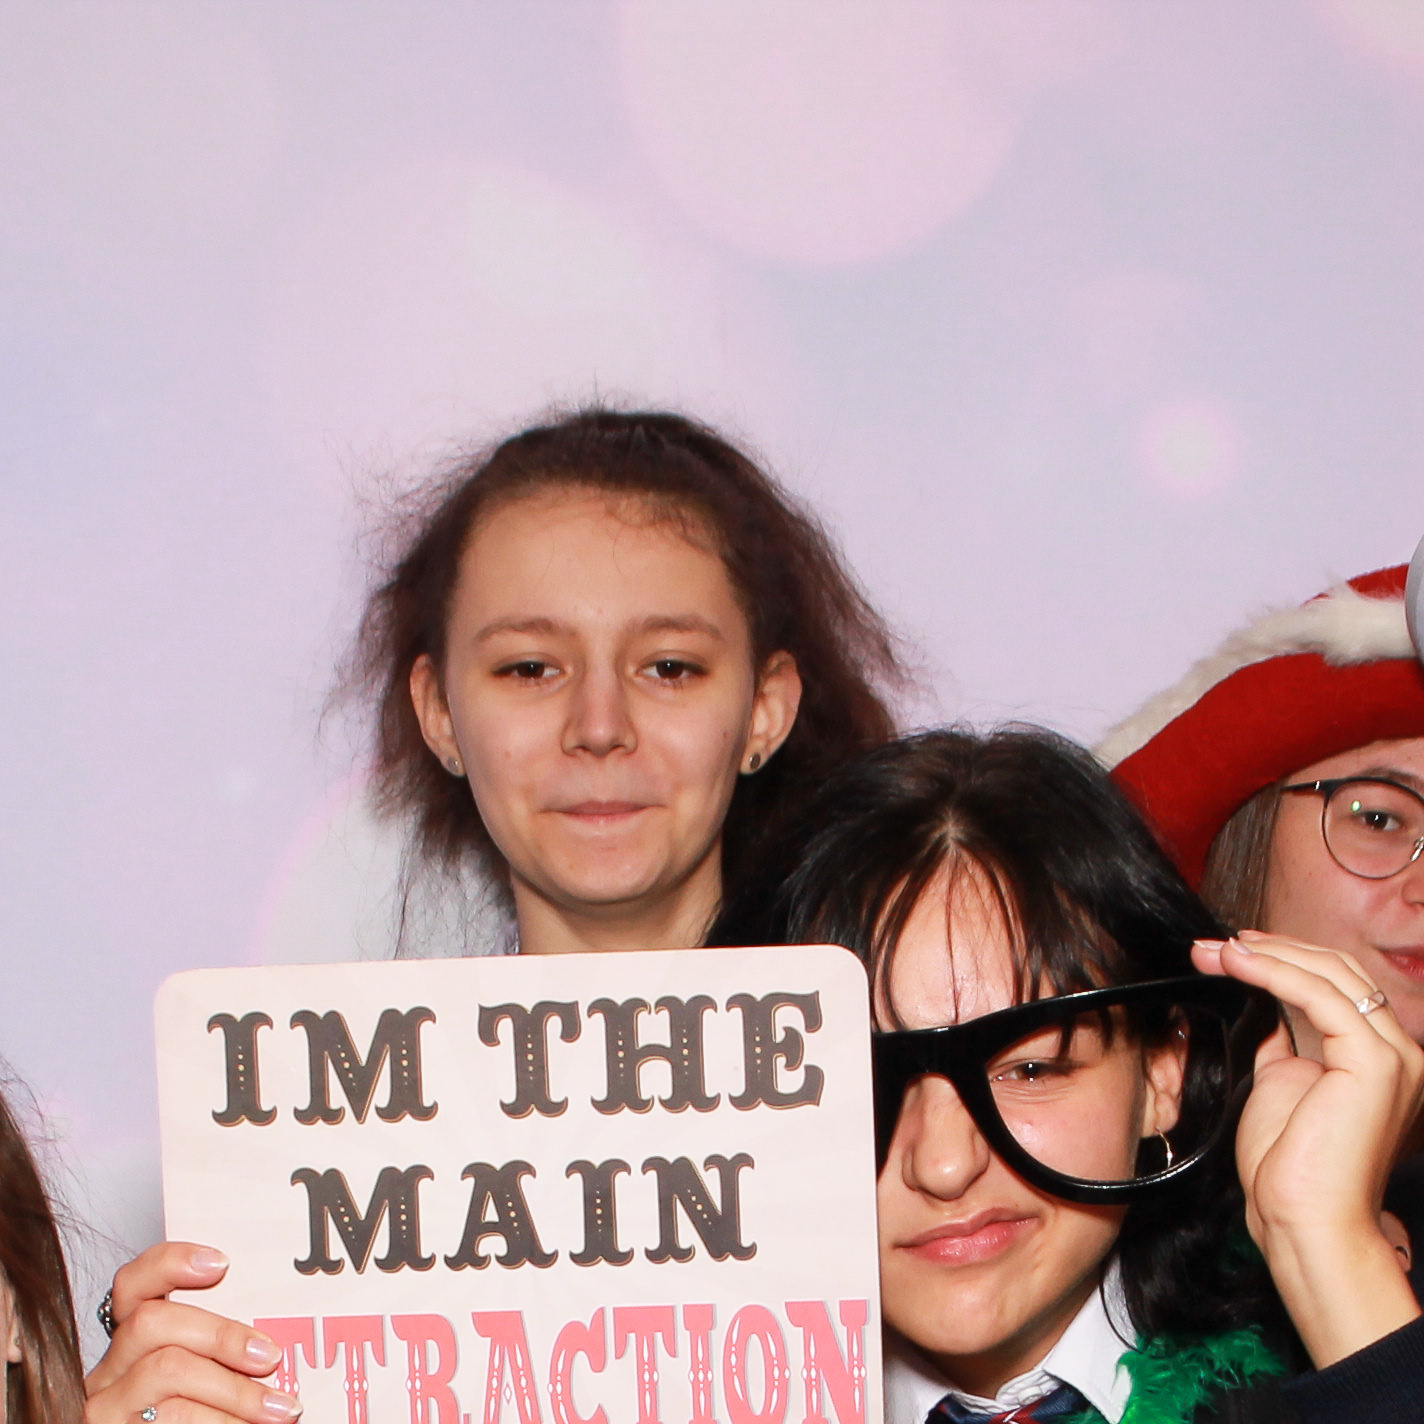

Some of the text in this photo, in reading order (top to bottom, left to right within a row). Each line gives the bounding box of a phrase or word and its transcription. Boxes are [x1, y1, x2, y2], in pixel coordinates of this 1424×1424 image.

[207, 990, 825, 1128] IM THE
[290, 1152, 758, 1276] MAIN
